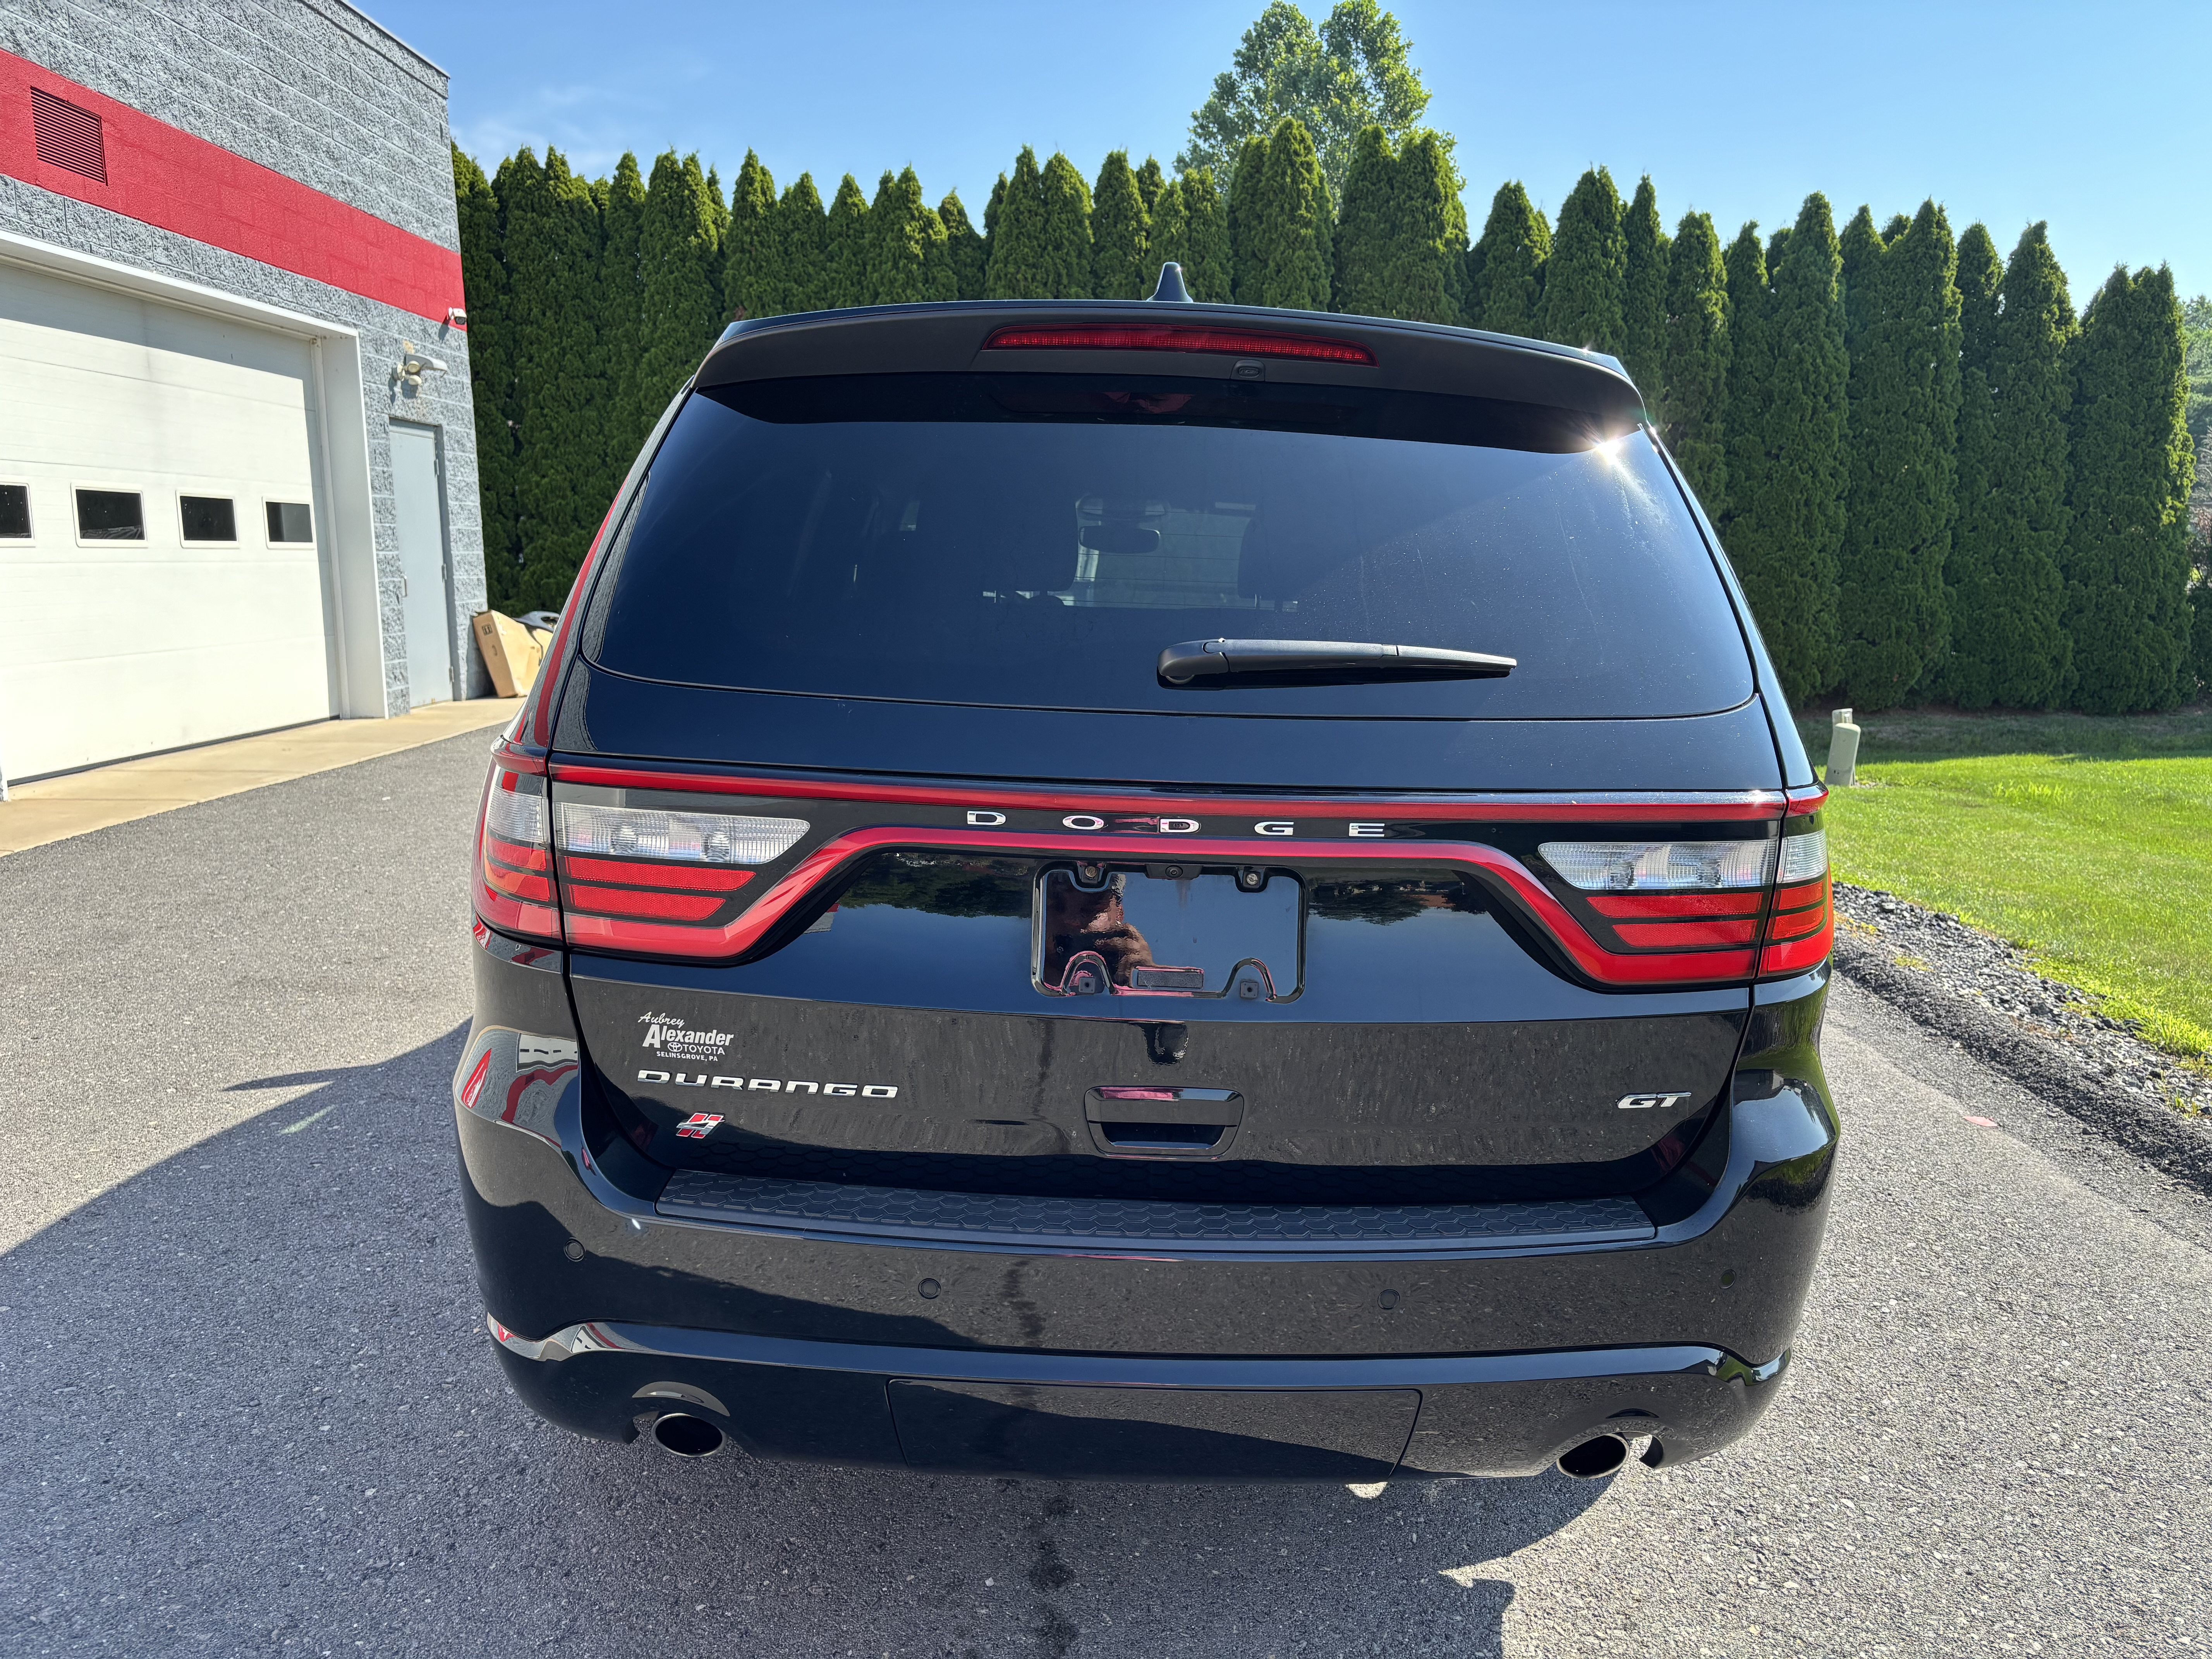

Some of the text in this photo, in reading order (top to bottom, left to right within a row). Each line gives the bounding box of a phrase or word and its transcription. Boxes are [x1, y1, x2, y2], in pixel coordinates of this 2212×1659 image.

[967, 811, 1385, 837] DODGE
[638, 1012, 685, 1028] Aubrey
[642, 1024, 734, 1048] Alexander
[656, 1051, 708, 1061] SELINSGROVE,
[682, 1044, 725, 1055] TOYOTA
[637, 1070, 898, 1099] DURANGO
[1618, 1092, 1692, 1109] GT
